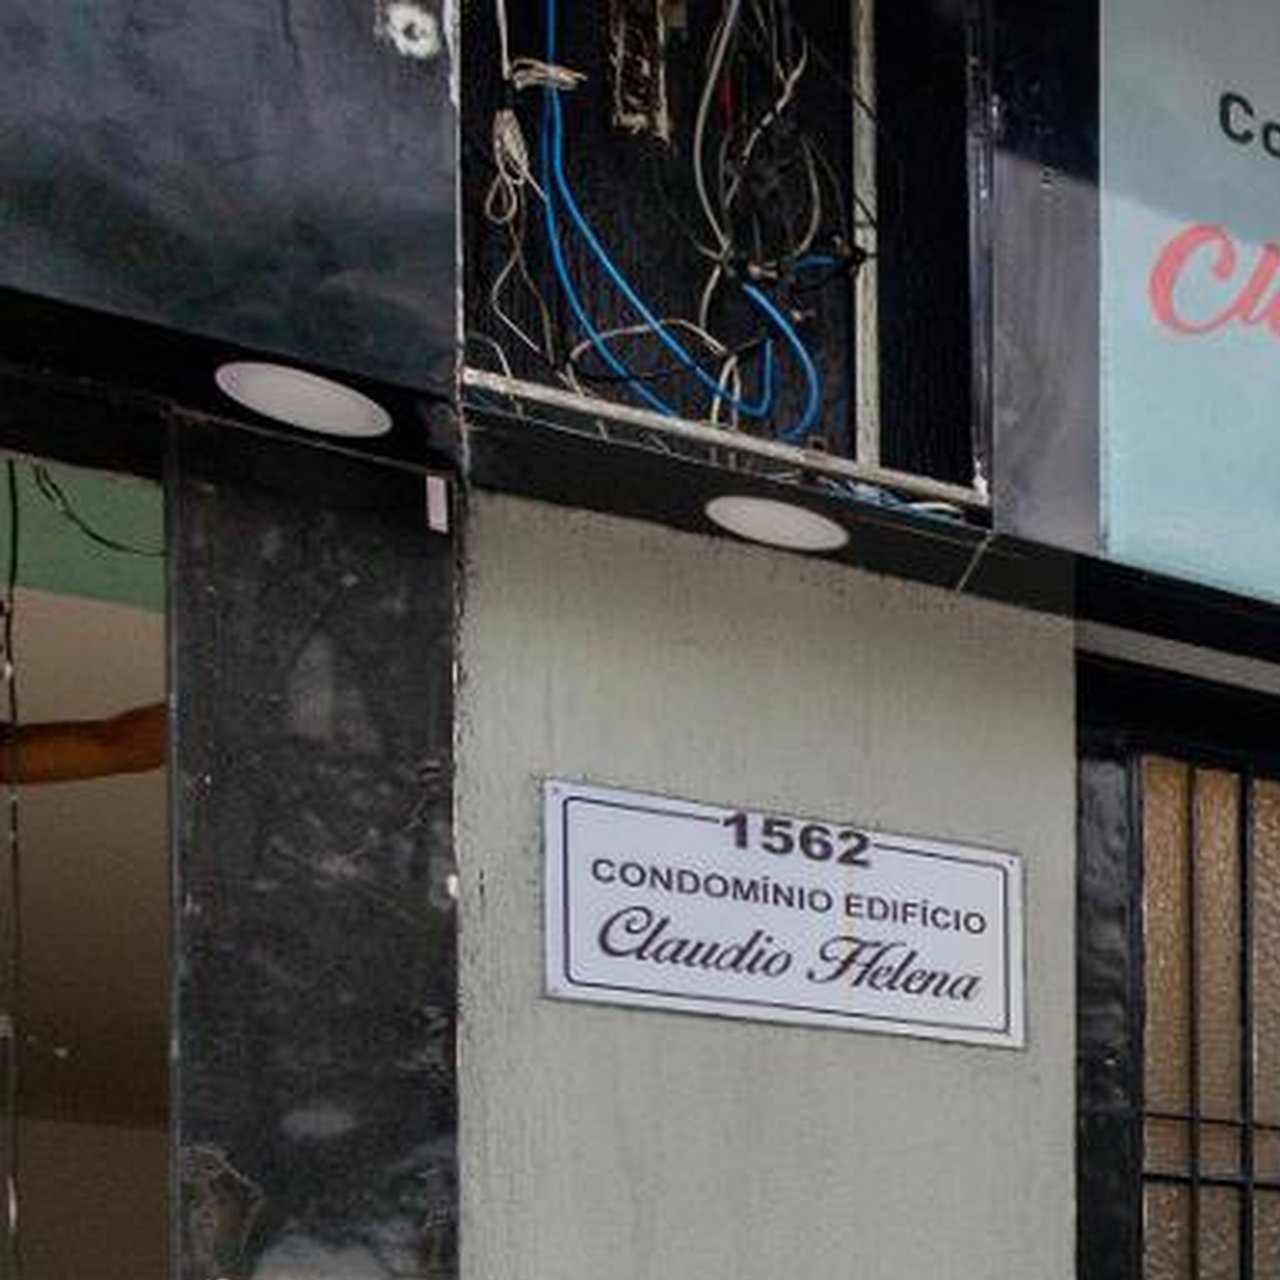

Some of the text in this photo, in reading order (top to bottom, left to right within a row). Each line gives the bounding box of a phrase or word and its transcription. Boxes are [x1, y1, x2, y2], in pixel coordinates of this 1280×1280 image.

[721, 811, 873, 869] 1562
[591, 857, 988, 936] CONDOMÍNIO EDIFÍCIO
[597, 904, 982, 1003] Claudio Helena
